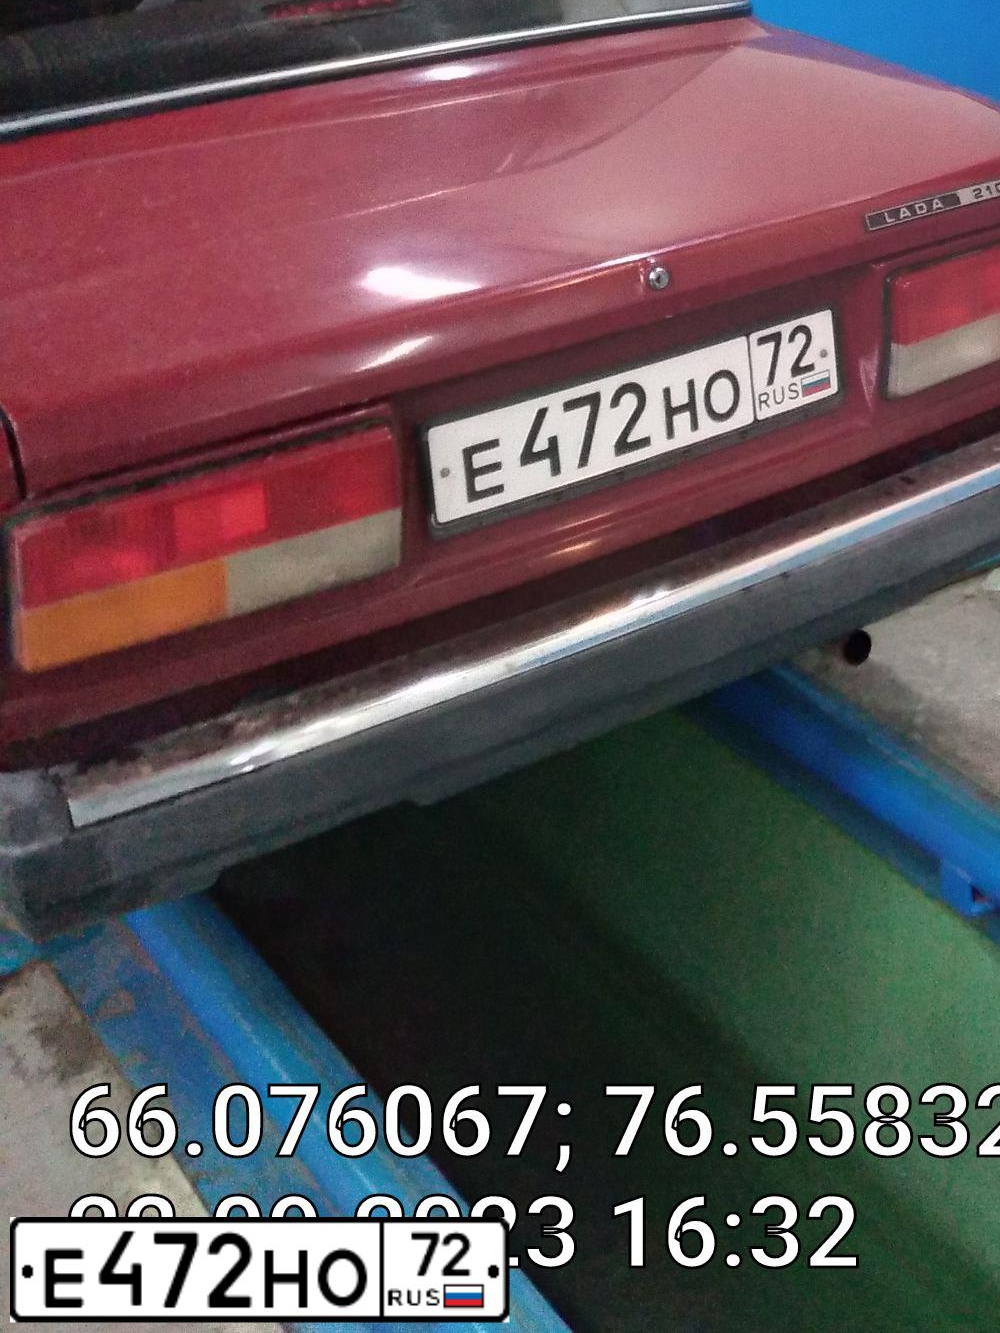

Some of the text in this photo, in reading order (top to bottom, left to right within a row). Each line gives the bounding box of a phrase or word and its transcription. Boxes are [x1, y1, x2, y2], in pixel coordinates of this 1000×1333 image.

[885, 199, 944, 223] LADA
[757, 324, 815, 387] 72
[758, 382, 800, 411] RUS
